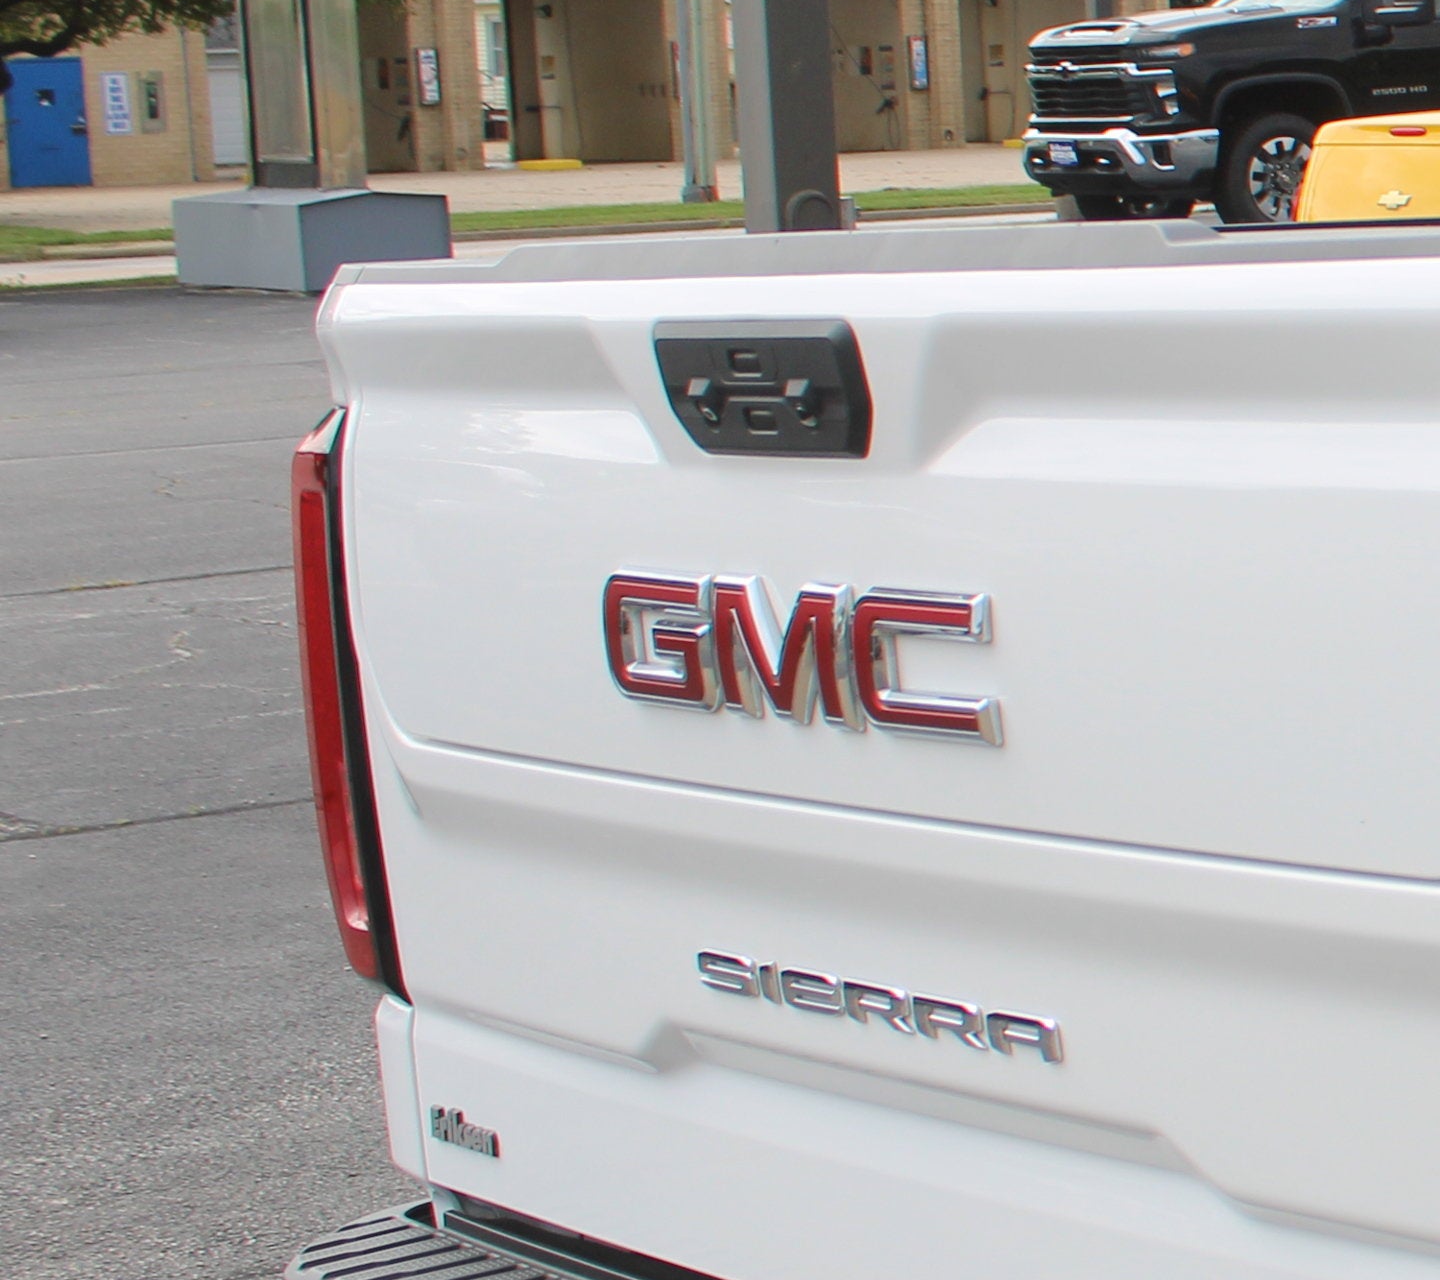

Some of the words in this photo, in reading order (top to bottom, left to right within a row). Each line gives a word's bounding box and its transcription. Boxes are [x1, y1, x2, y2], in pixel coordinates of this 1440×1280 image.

[603, 568, 1004, 747] GMC
[696, 946, 1065, 1065] SIERRA
[430, 1104, 501, 1158] Eriksen
